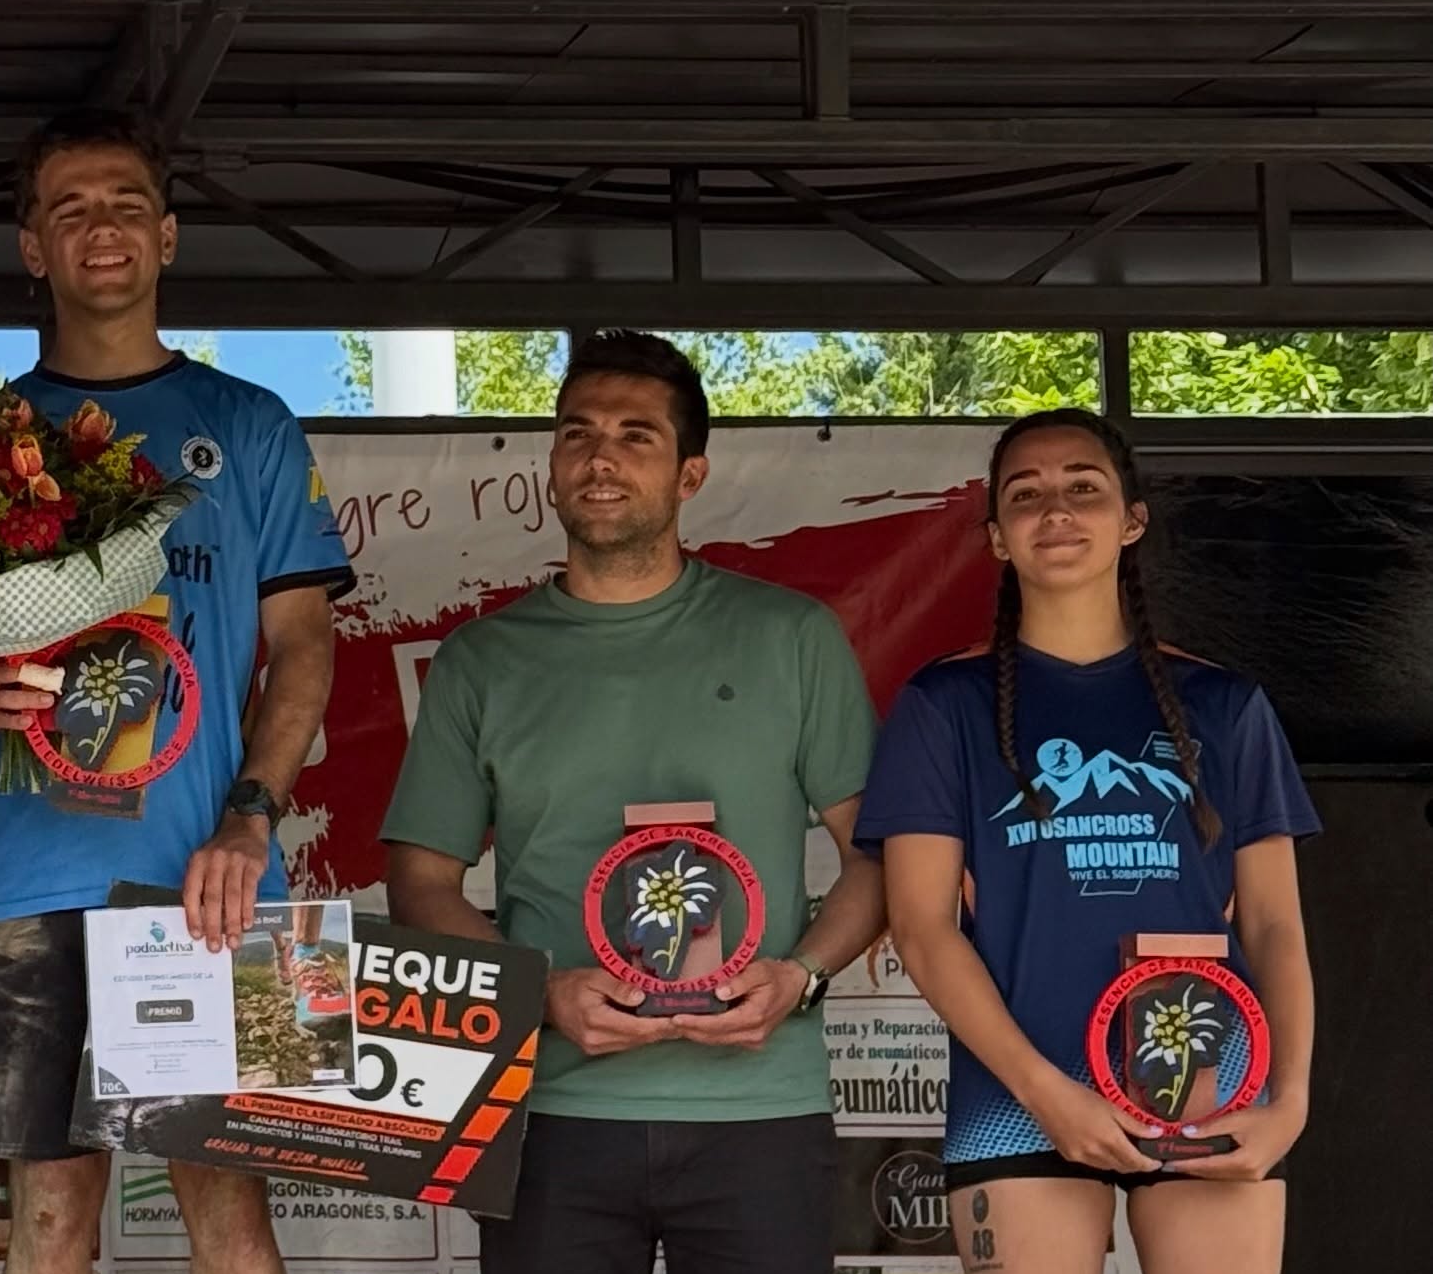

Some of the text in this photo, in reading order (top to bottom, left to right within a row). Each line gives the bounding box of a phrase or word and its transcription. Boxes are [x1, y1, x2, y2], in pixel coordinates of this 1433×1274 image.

[1006, 820, 1037, 847] XVI
[1066, 841, 1180, 869] MOUNTAIN
[126, 940, 195, 961] podoactiva
[847, 1043, 865, 1060] de
[868, 1042, 947, 1060] neumáticos
[376, 1118, 438, 1138] ABSOLUTO
[291, 1200, 390, 1222] ARAGONÉS,
[393, 1205, 427, 1220] S.A.
